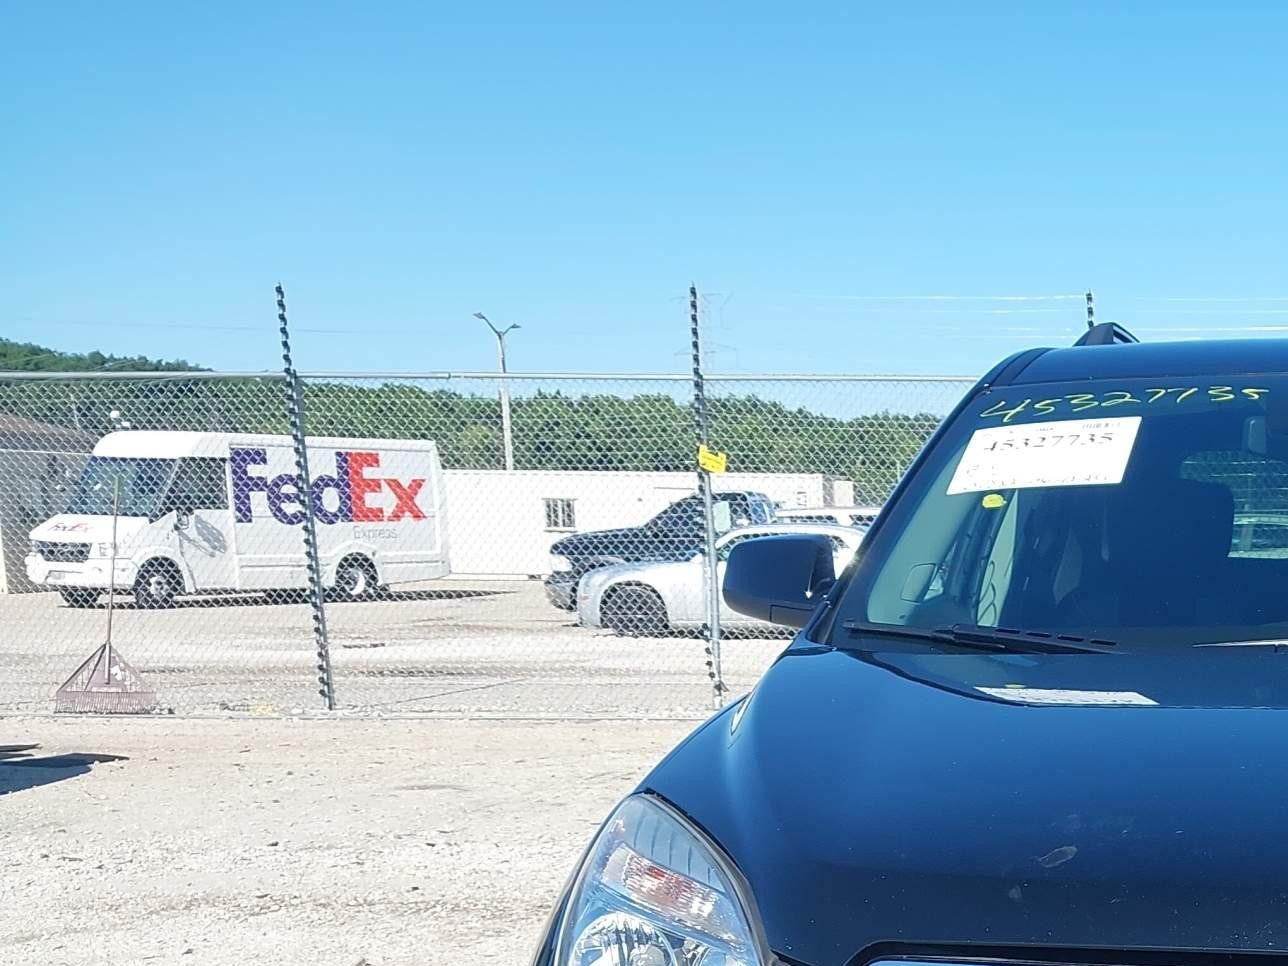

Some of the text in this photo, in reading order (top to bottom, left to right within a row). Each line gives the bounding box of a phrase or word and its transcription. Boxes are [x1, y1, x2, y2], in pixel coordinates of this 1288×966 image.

[979, 386, 1270, 423] 45327735
[983, 432, 1114, 452] 45327735
[229, 447, 427, 526] FedEx
[353, 526, 398, 540] Express
